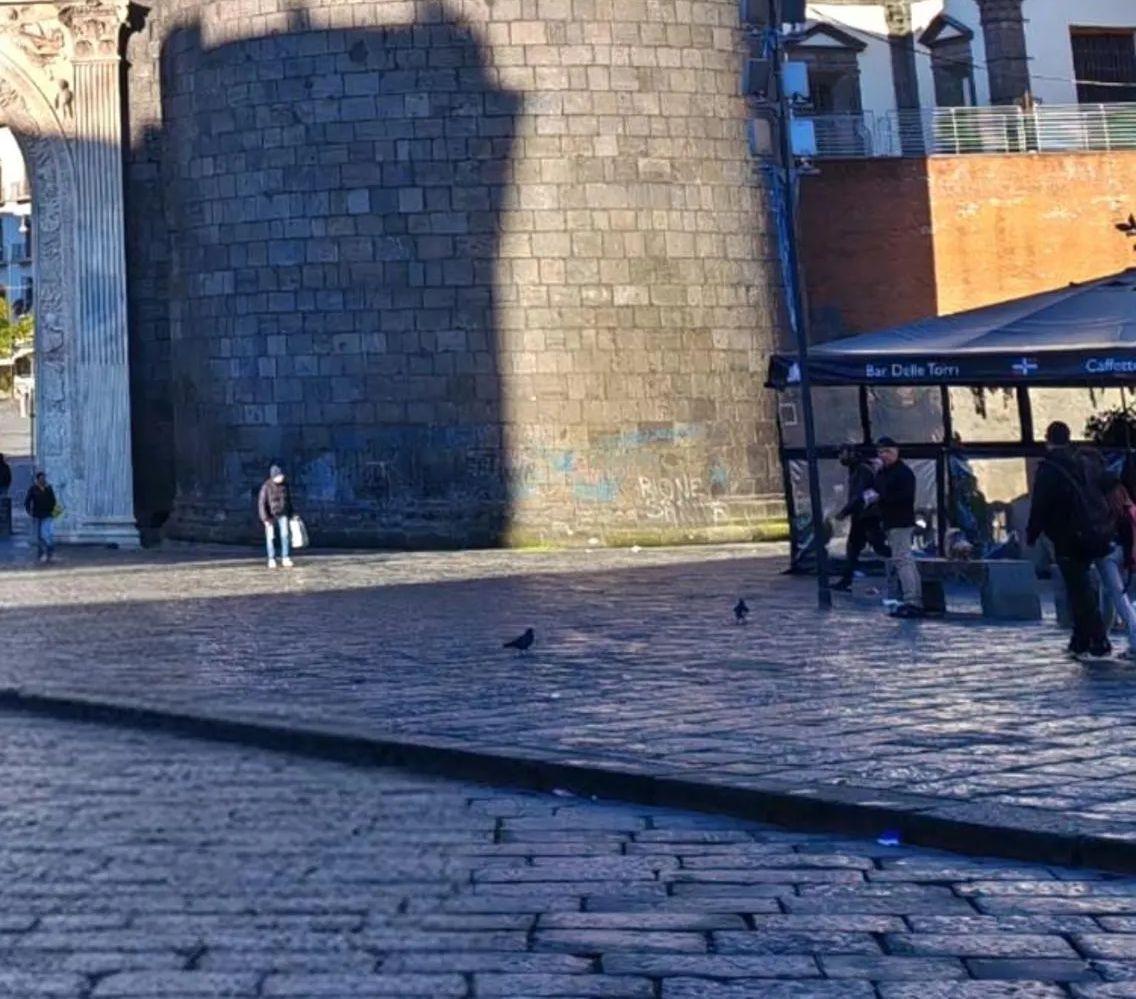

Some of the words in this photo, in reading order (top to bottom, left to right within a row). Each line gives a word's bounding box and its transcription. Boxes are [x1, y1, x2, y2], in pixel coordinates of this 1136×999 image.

[866, 364, 887, 377] Bar
[891, 364, 924, 377] Delle
[927, 362, 959, 376] Torri
